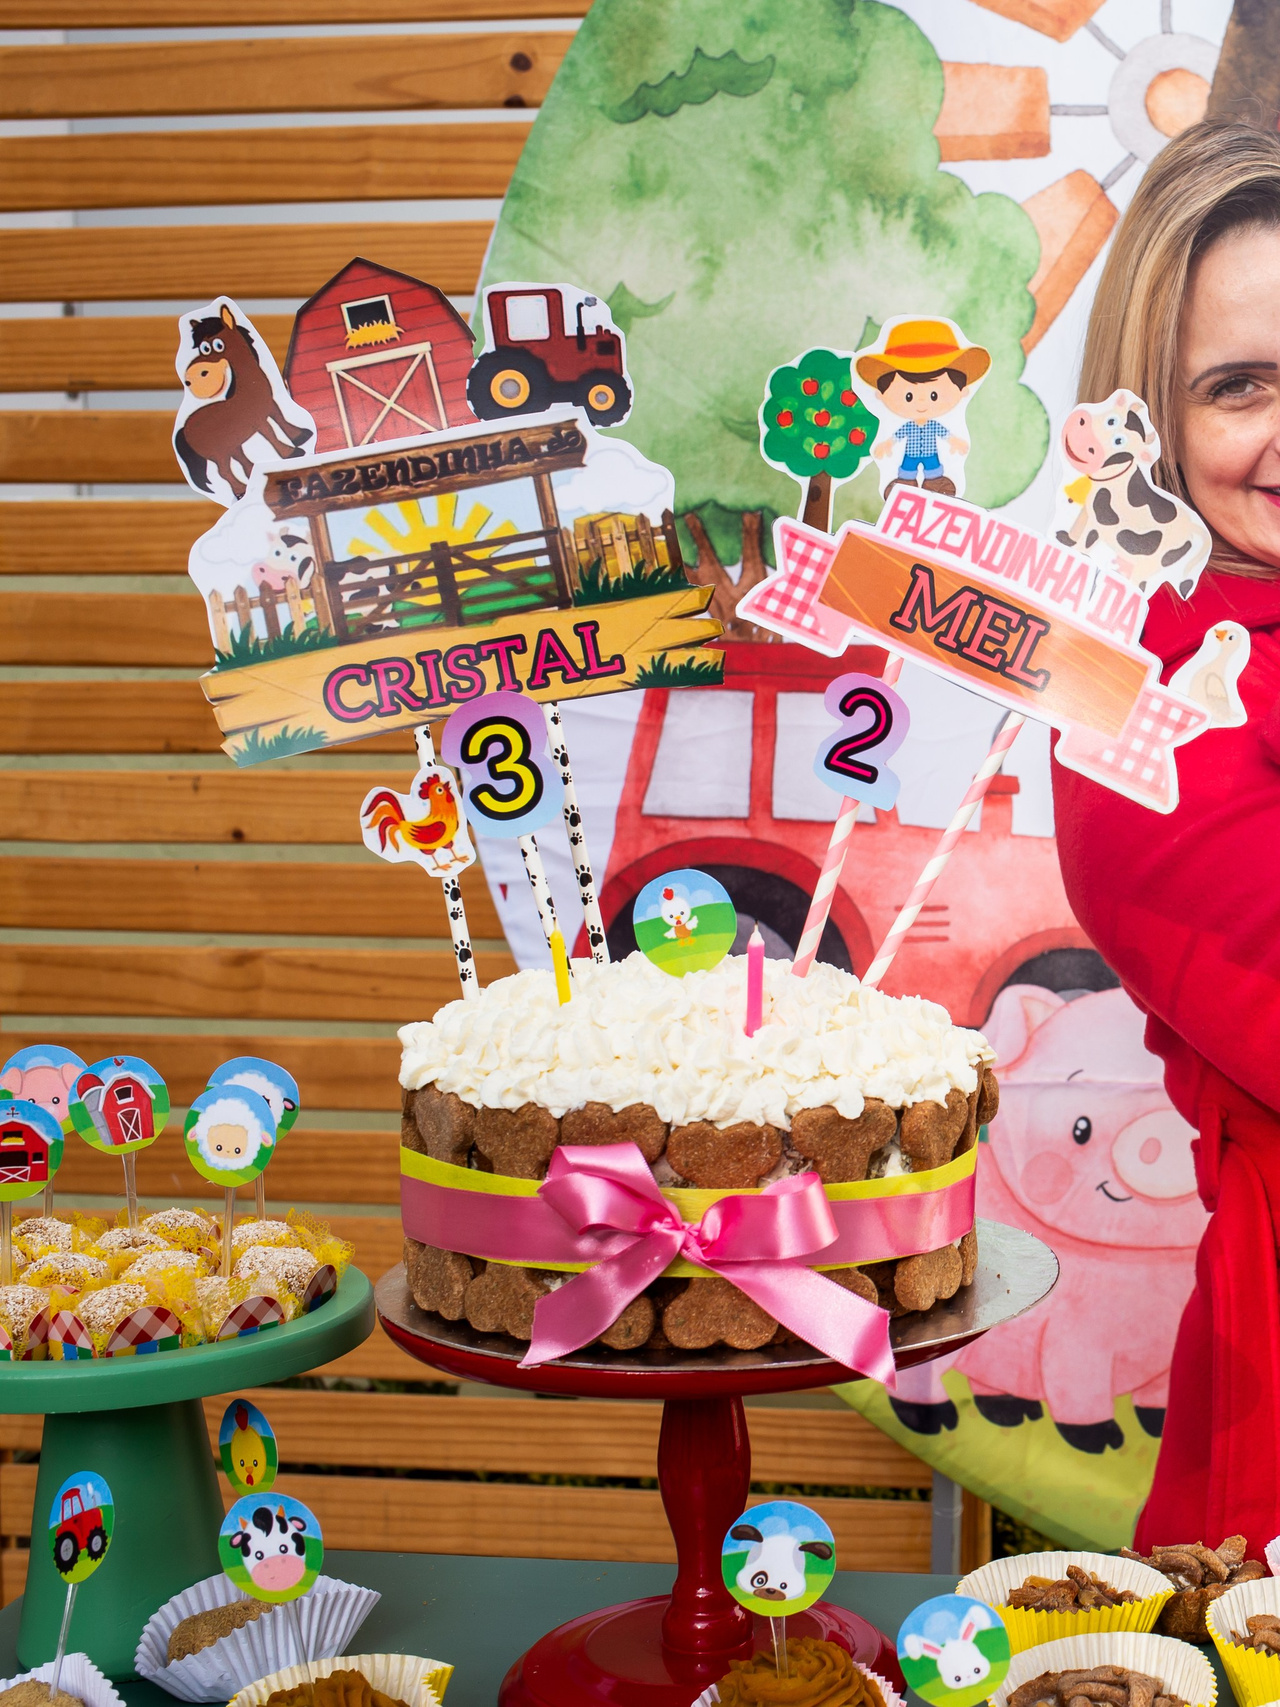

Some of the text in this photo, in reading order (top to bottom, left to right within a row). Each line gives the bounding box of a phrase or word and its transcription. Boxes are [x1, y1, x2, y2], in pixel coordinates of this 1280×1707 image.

[278, 436, 533, 507] FAZENDINHA
[881, 490, 1144, 646] FAZENDINHA DA
[322, 620, 626, 723] CRISTAL
[889, 563, 1051, 692] MEL
[460, 715, 544, 821] 3
[823, 686, 894, 784] 2
